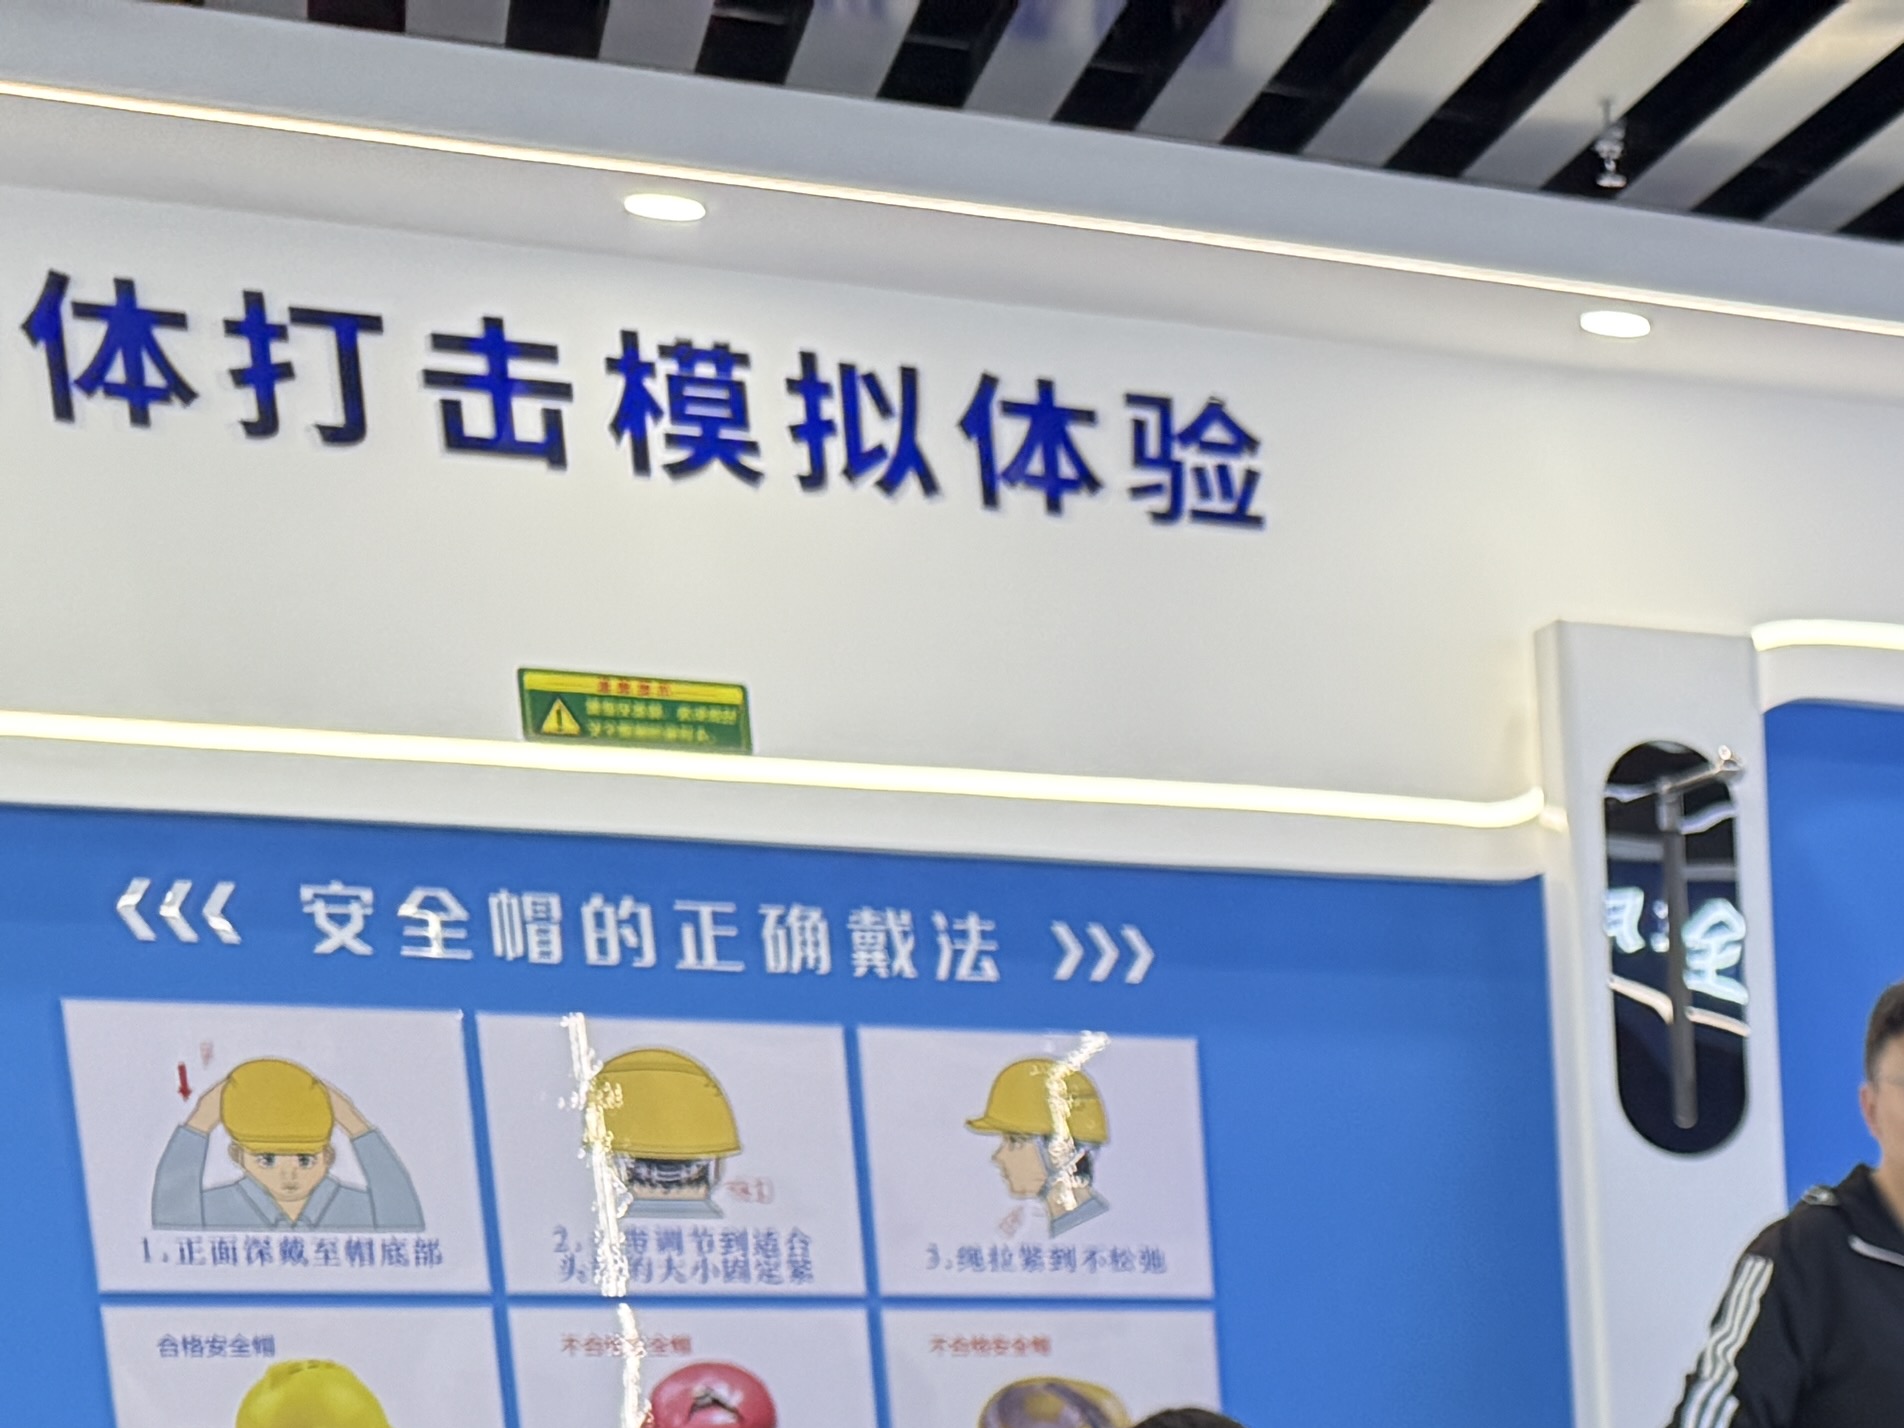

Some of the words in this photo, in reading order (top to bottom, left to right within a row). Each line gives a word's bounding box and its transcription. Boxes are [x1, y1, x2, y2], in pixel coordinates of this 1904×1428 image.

[22, 268, 1269, 530] 体打击模拟体验
[301, 880, 1001, 982] 安全帽的正确戴法
[142, 1236, 443, 1268] 1.正面深戴至帽底部
[157, 1333, 275, 1358] 合格安全帽
